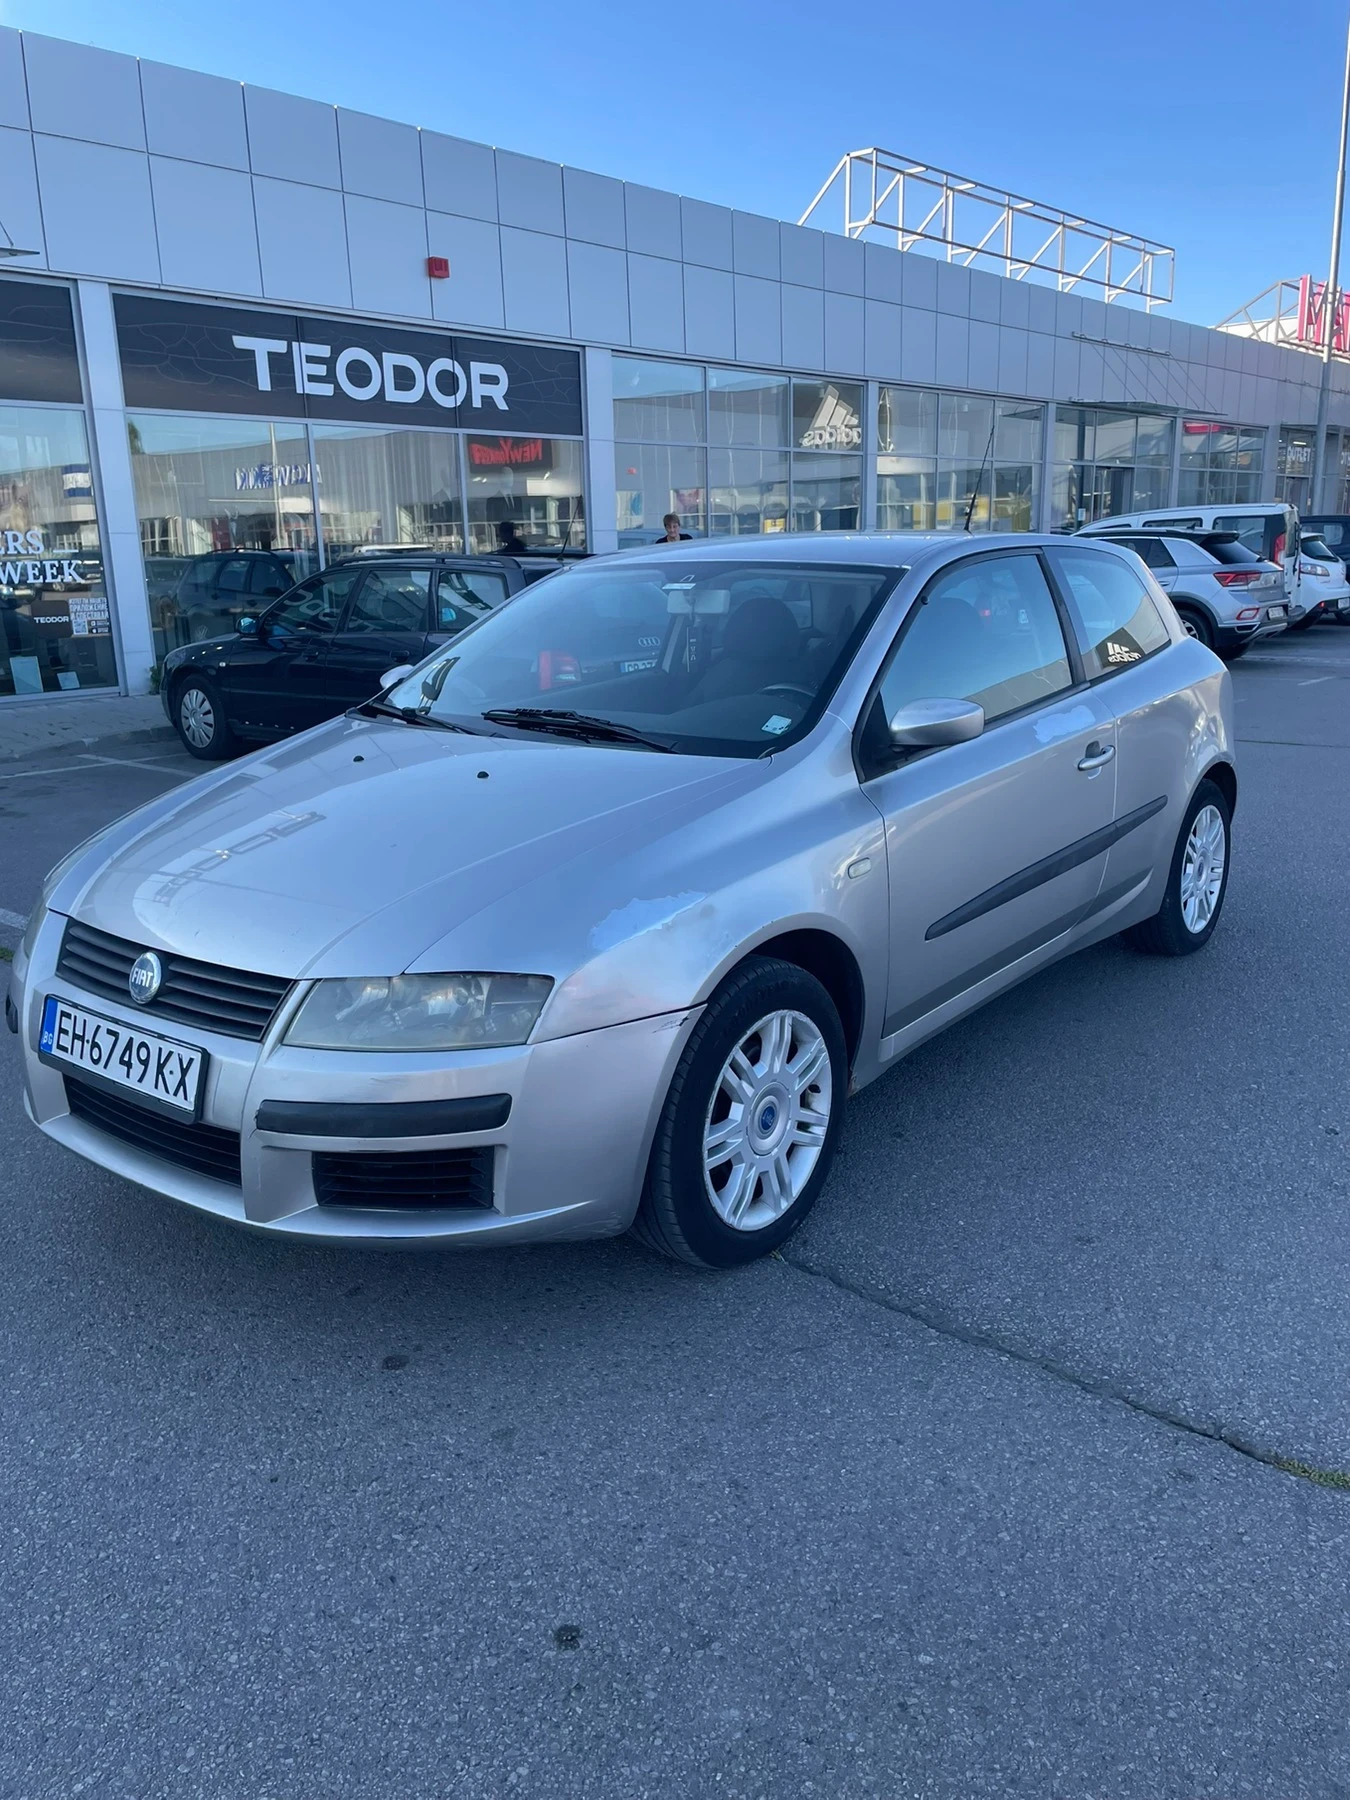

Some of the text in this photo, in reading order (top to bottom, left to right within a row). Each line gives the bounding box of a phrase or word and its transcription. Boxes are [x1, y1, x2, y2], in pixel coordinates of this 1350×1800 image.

[231, 335, 510, 410] TEODOR
[0, 530, 45, 554] RS
[0, 560, 85, 584] WEEK
[34, 616, 69, 624] TEODOR
[131, 967, 154, 987] FIAT
[43, 1031, 54, 1045] BG
